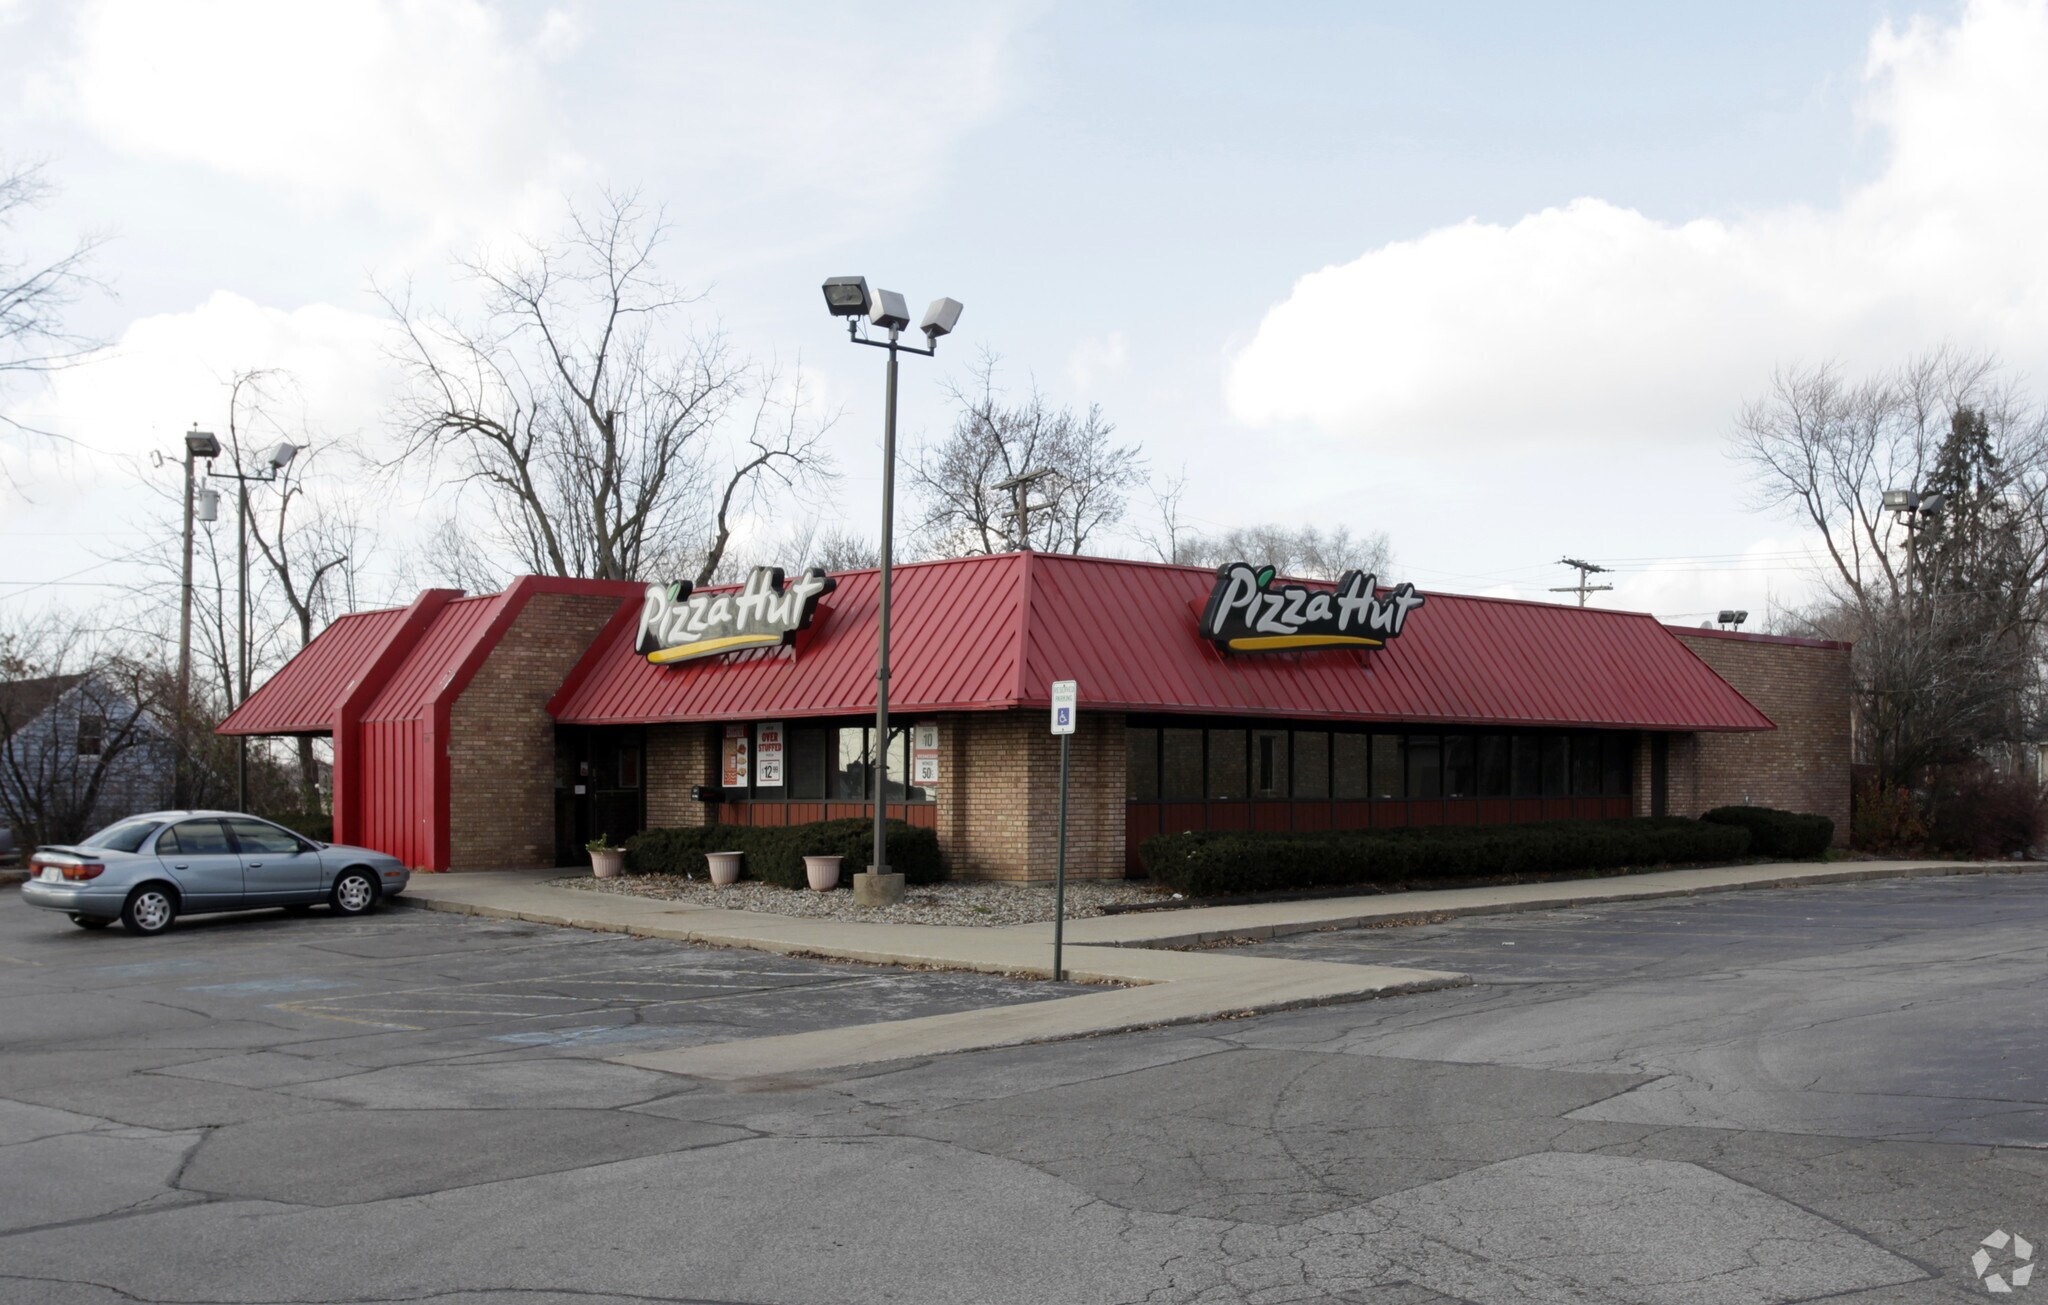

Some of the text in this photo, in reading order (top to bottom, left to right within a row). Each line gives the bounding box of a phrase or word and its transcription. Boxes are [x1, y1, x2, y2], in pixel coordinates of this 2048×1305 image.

[636, 569, 824, 651] Pizza Hut
[1212, 566, 1424, 635] Pizza Hut
[758, 743, 782, 752] STUFFED
[761, 731, 778, 742] OVER
